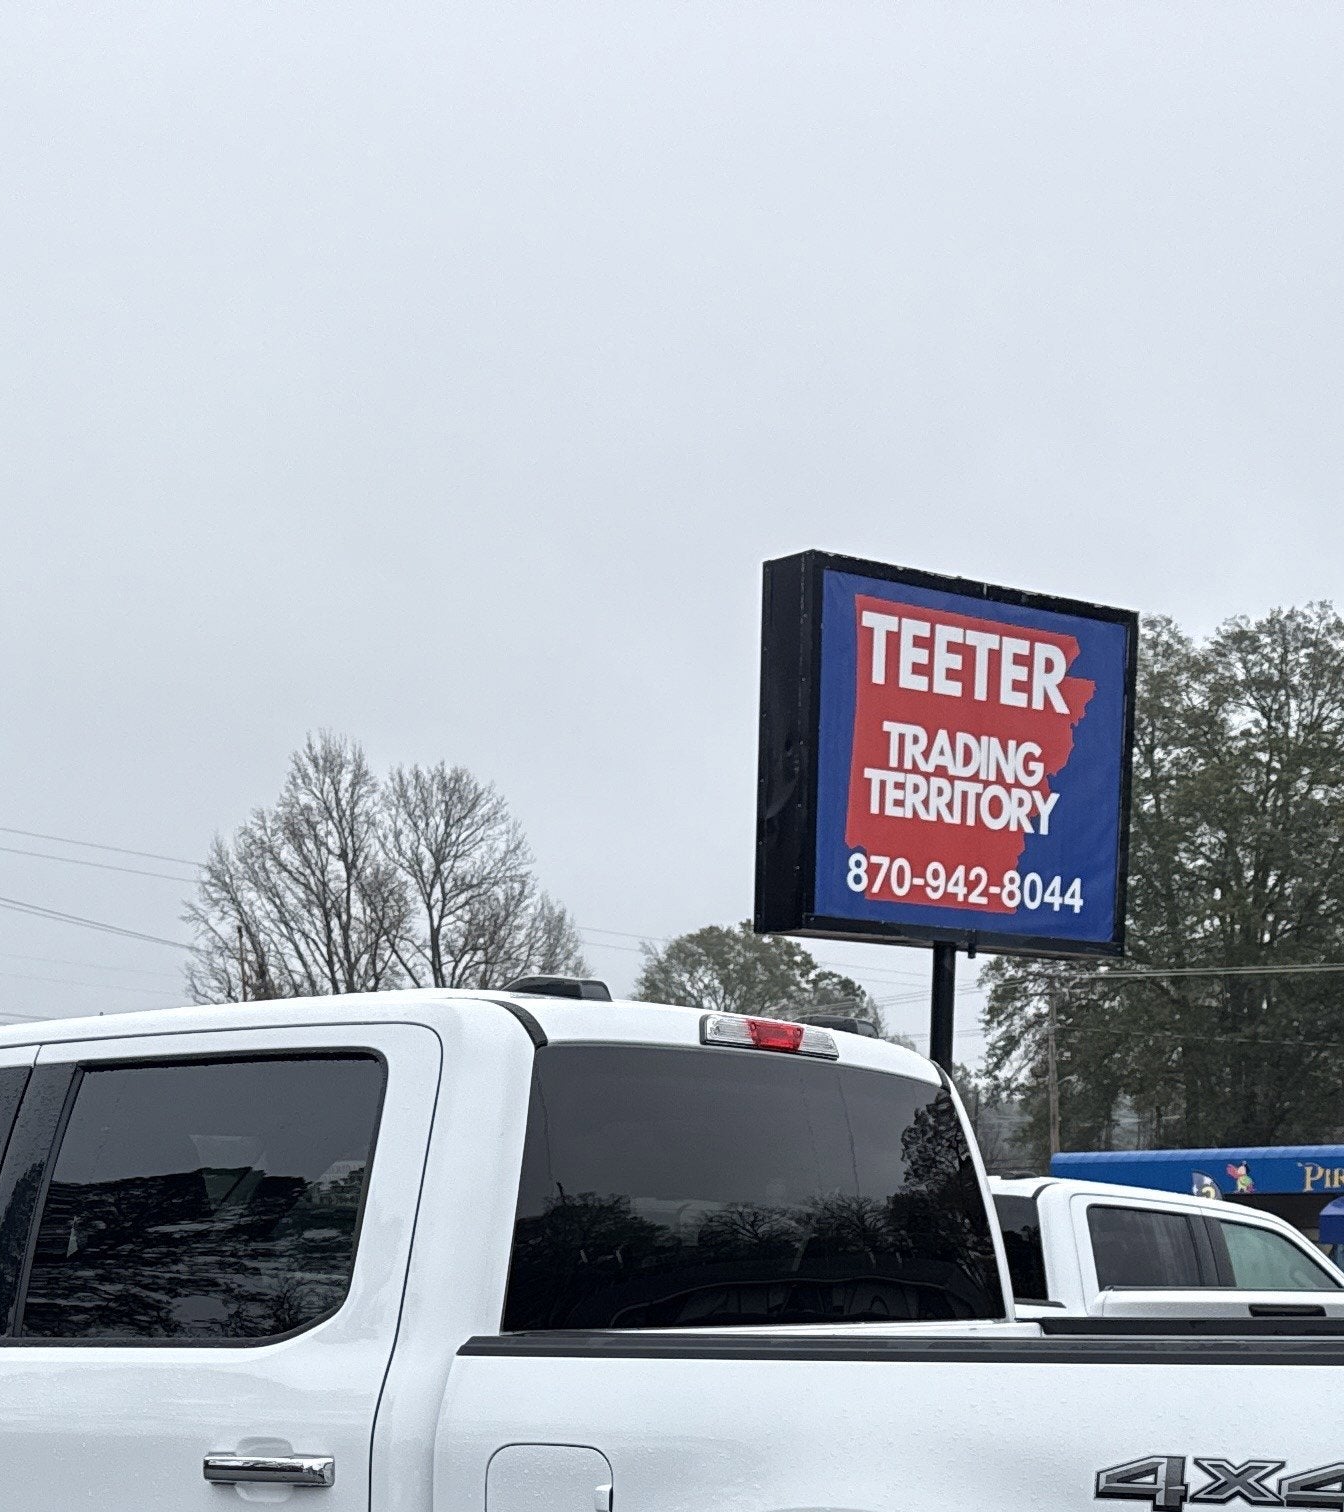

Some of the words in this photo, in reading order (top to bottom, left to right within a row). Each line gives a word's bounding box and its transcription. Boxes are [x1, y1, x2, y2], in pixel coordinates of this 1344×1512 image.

[861, 610, 1071, 715] TEETER
[882, 720, 1045, 787] TRADING
[863, 767, 1060, 836] TERRITORY
[846, 852, 1084, 914] 870-942-8044
